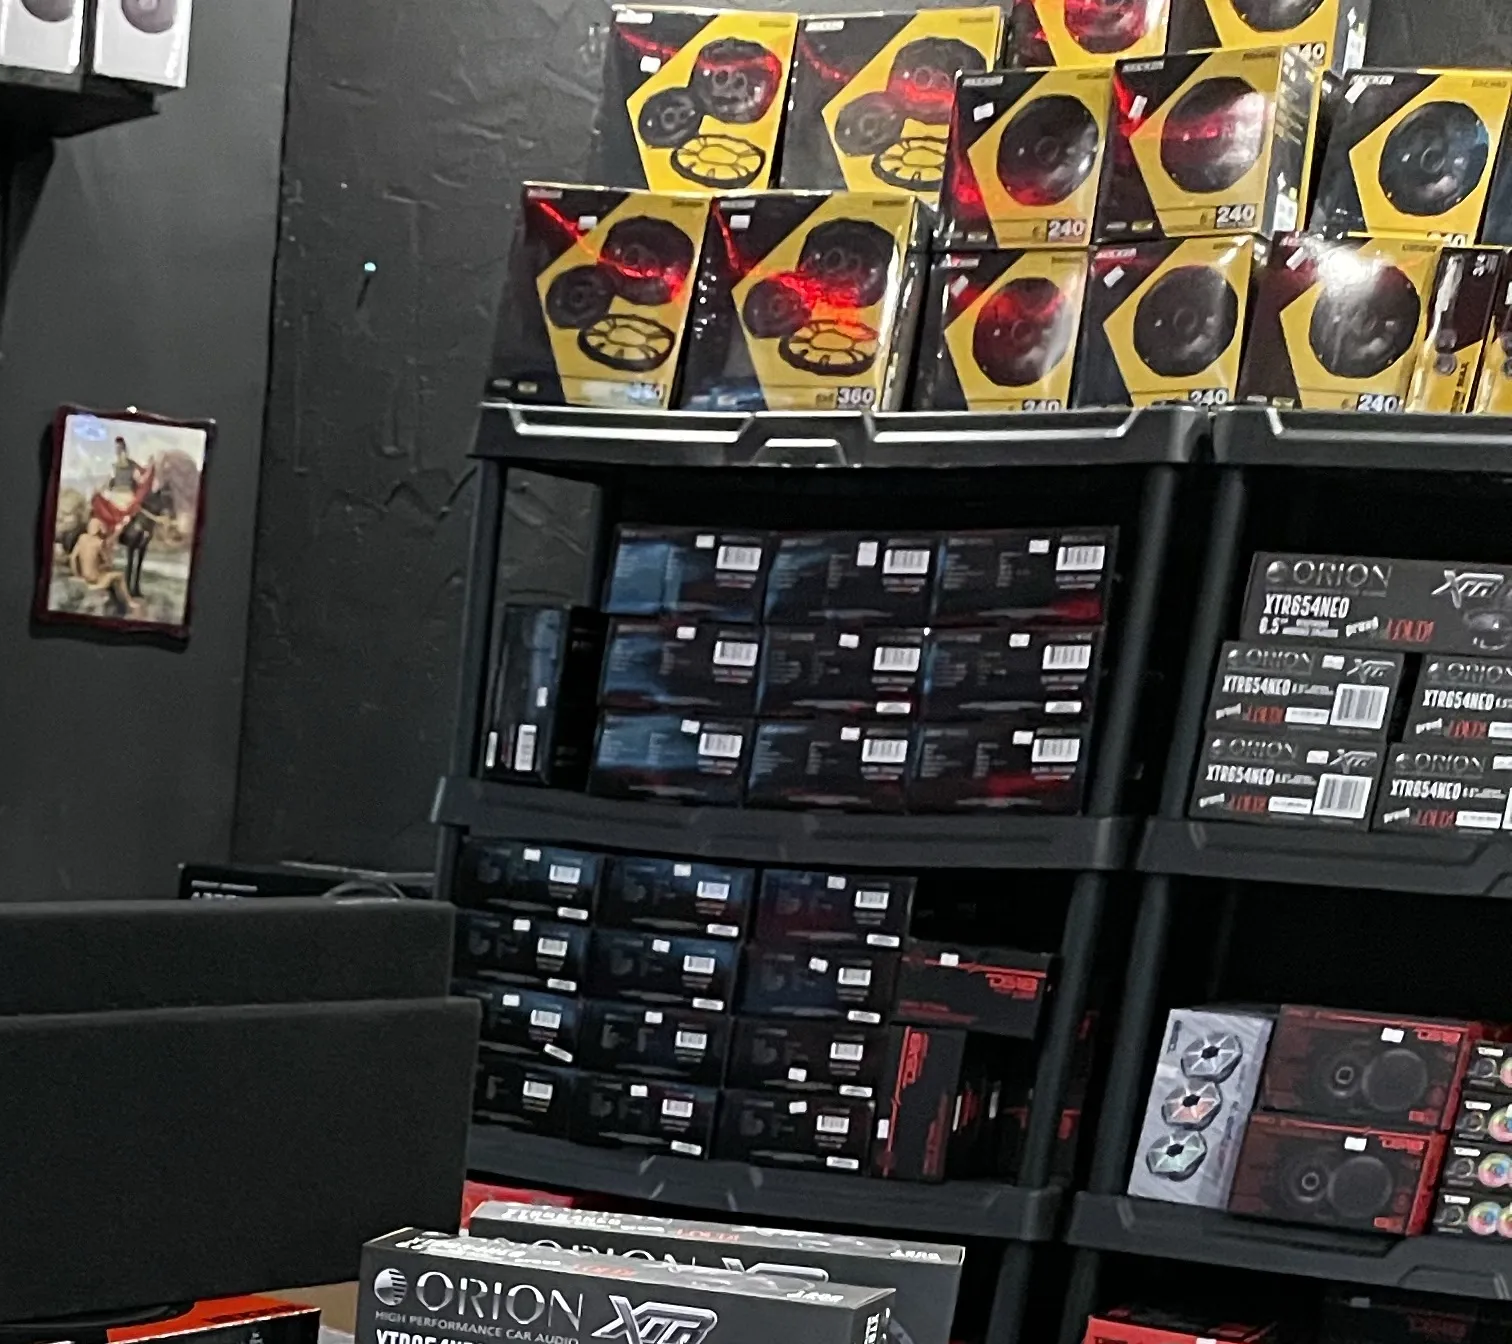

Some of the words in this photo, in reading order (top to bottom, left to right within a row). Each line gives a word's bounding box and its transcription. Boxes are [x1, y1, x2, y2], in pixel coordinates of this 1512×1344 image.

[1217, 205, 1255, 227] 240
[1048, 220, 1085, 241] 240
[1293, 561, 1391, 588] ORION
[1263, 594, 1349, 618] XTR654NEO
[416, 1271, 583, 1332] ORION
[375, 1311, 407, 1325] HIGH
[409, 1313, 501, 1338] PERFORMANCE
[506, 1329, 532, 1342] CAR
